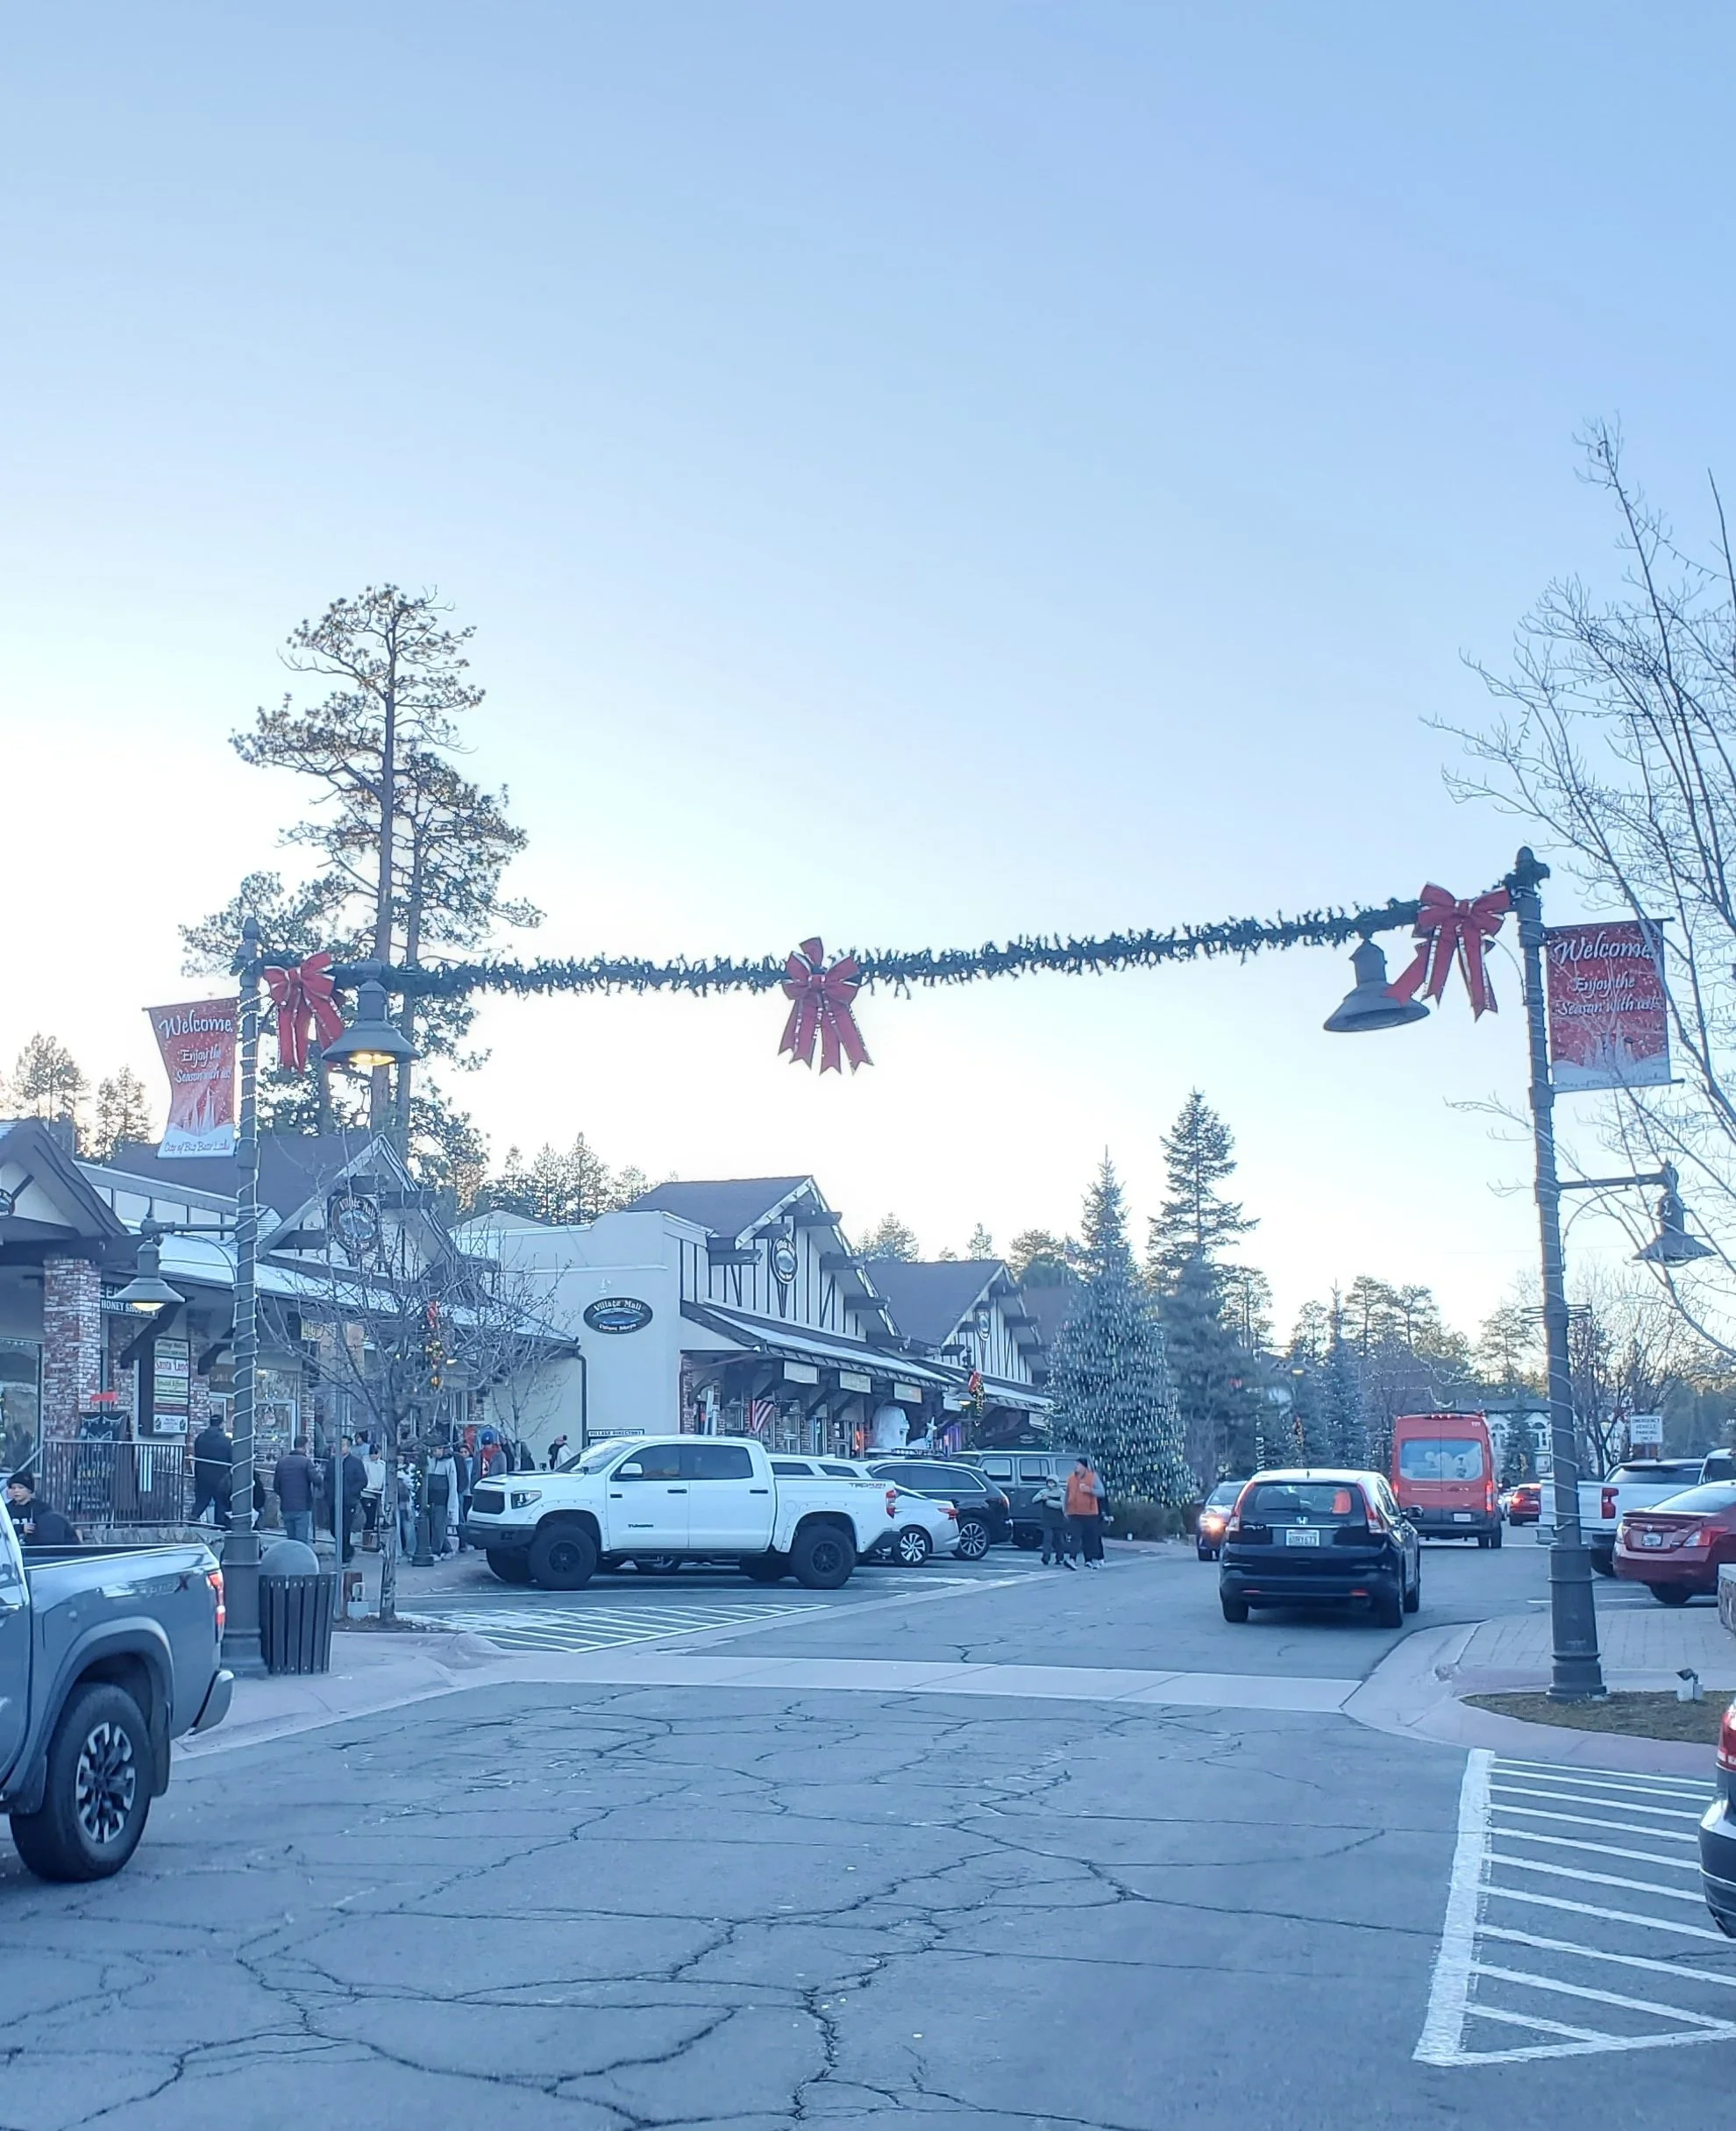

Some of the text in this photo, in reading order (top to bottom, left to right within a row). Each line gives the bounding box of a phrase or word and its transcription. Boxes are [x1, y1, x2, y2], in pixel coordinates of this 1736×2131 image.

[1572, 971, 1635, 999] Enjoy the
[1557, 1001, 1603, 1016] Season
[1605, 993, 1634, 1013] with
[181, 1048, 209, 1068] Enjoy
[176, 1069, 203, 1084] Season
[101, 1300, 124, 1312] HONEY
[594, 1300, 643, 1311] Village Mall
[155, 1360, 172, 1372] Santa
